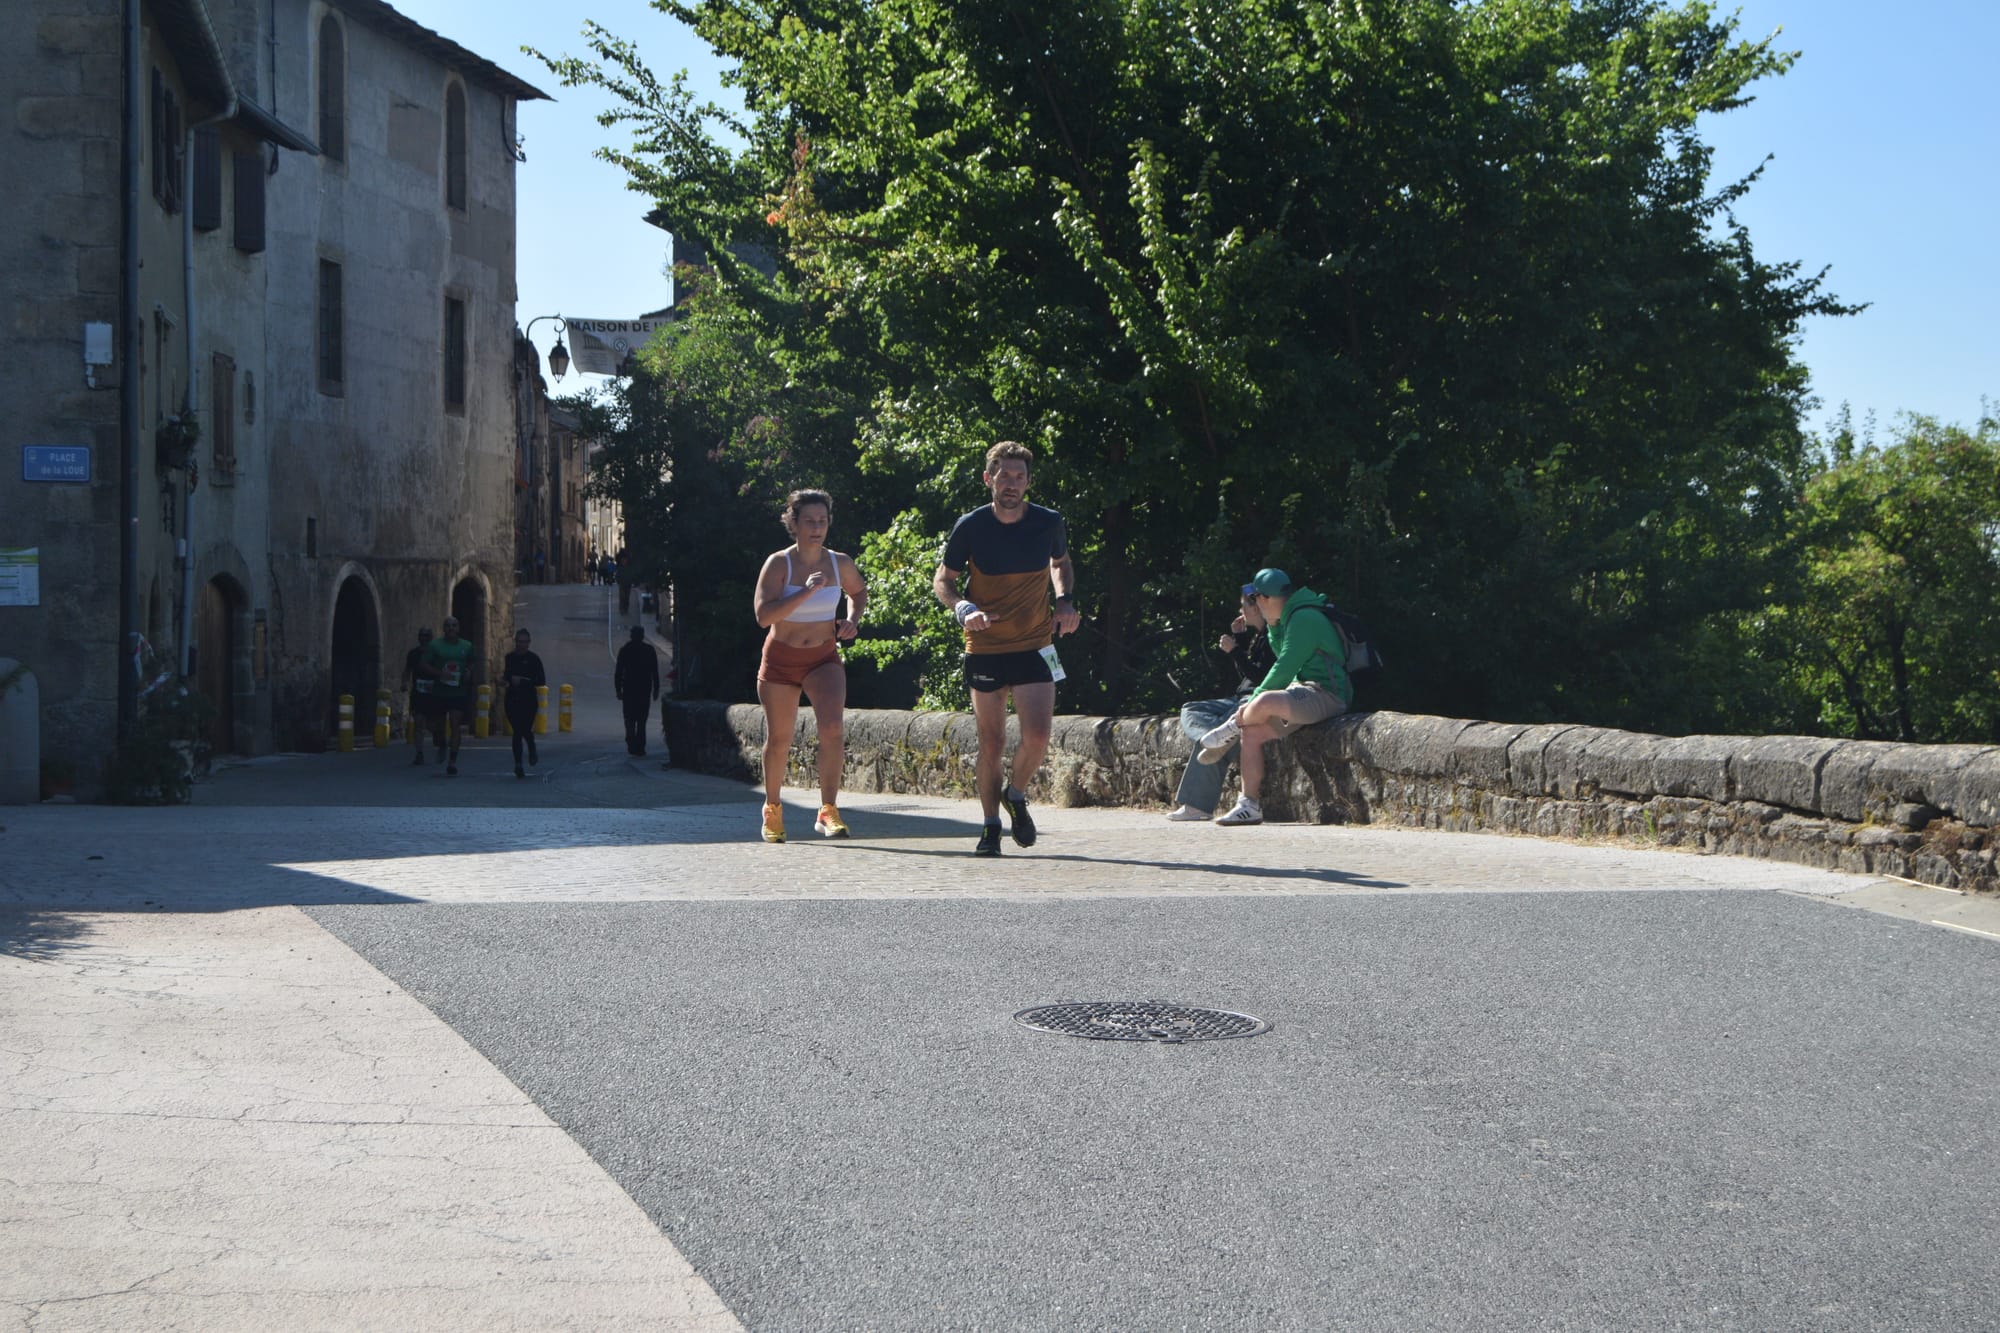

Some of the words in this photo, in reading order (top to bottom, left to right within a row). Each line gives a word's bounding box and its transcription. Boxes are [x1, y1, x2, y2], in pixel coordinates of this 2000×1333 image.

[571, 321, 628, 332] MAISON
[632, 322, 650, 332] DE
[50, 453, 76, 462] PLACE
